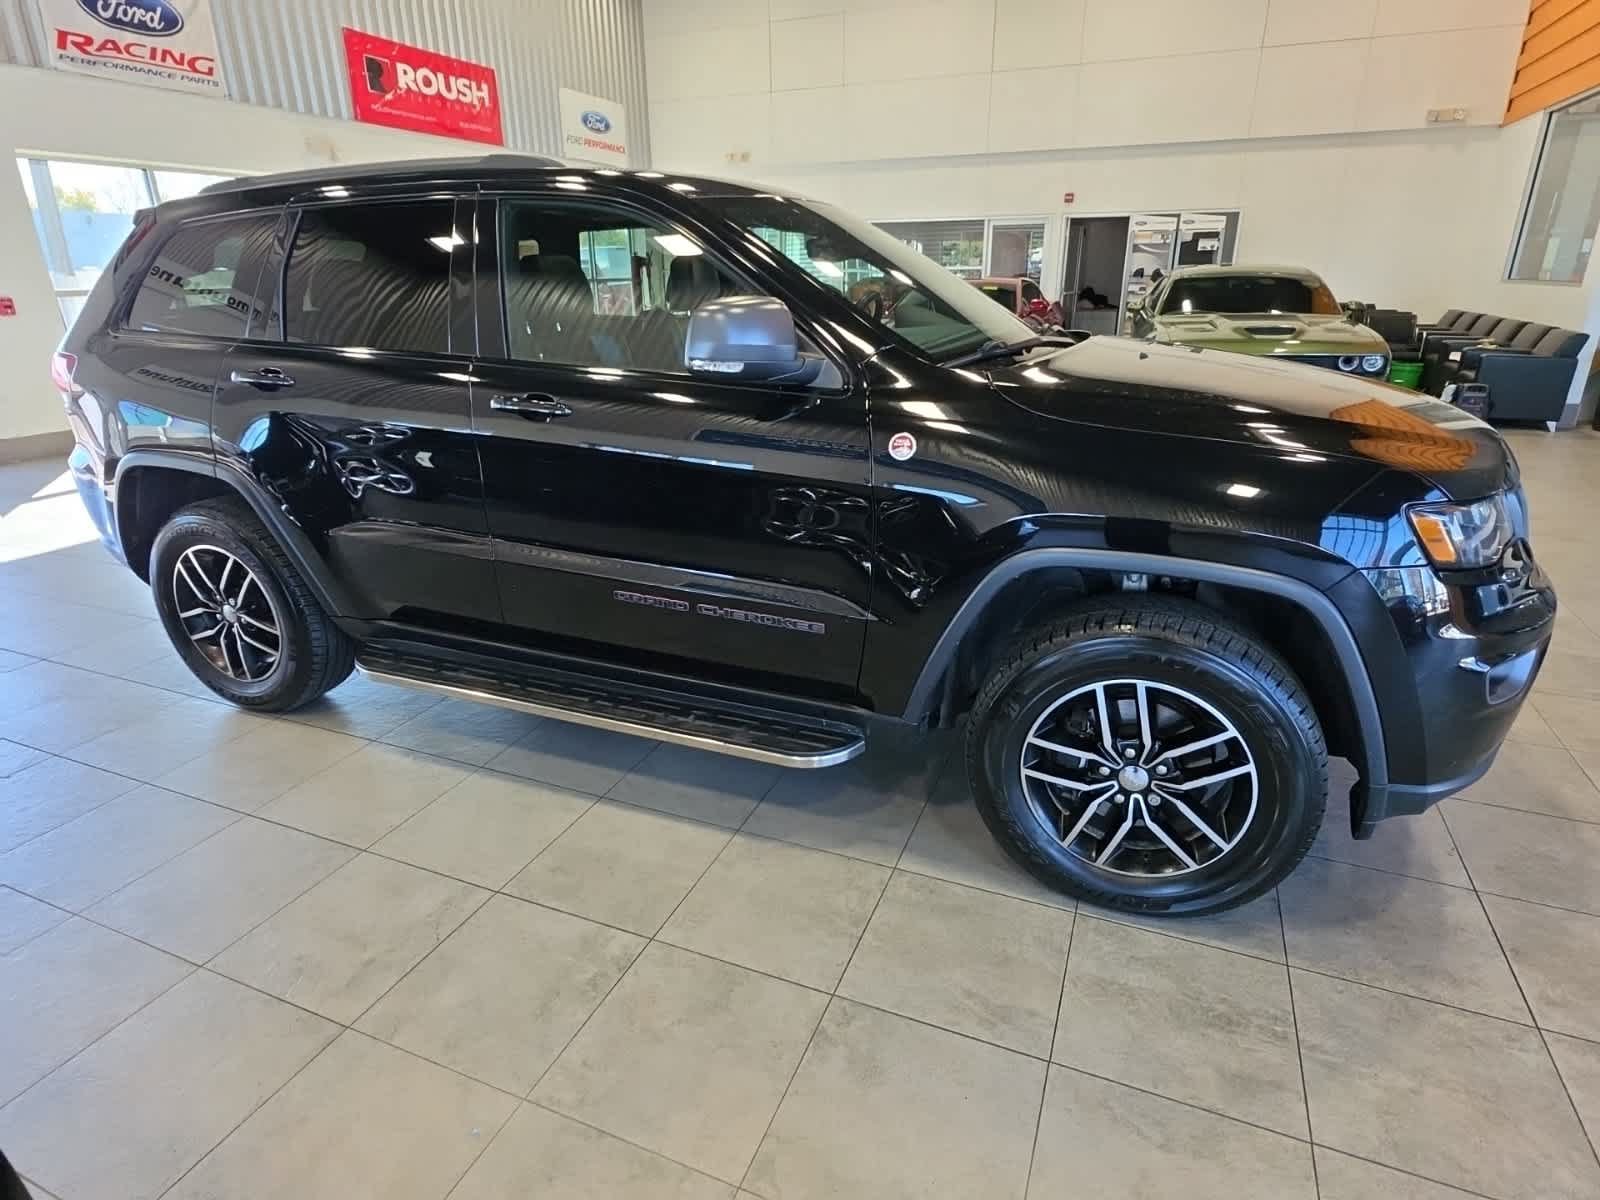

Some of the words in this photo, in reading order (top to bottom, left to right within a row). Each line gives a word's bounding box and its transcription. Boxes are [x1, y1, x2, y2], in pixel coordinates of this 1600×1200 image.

[54, 28, 215, 77] RACING
[58, 53, 176, 80] PERFORMANCE
[180, 74, 220, 88] PARTS
[395, 61, 490, 107] ROUSH
[697, 603, 825, 634] CHEROKEE
